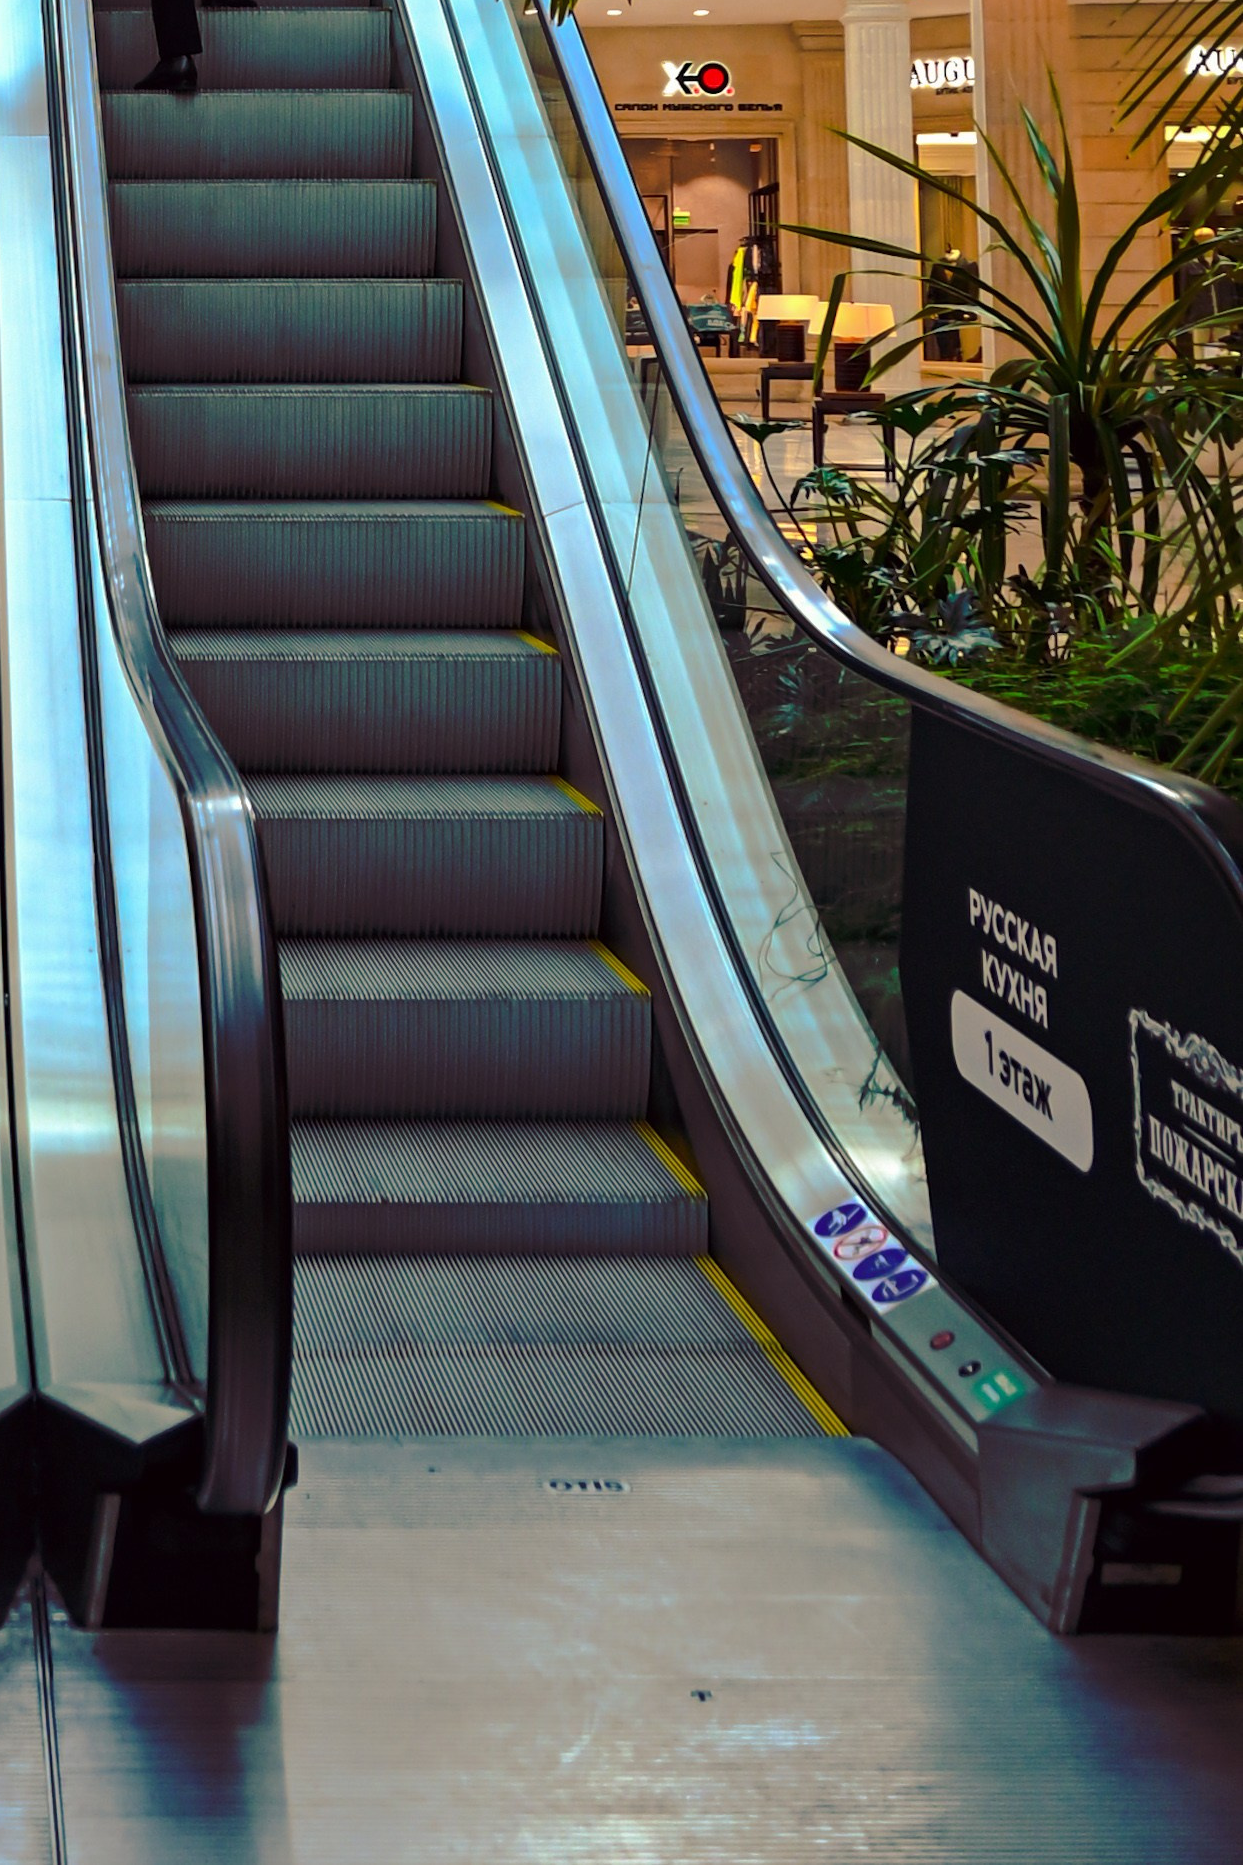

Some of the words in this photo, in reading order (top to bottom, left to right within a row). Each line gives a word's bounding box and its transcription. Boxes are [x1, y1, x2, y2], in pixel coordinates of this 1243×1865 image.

[969, 887, 1058, 979] РУССКАЯ
[982, 948, 1049, 1030] КУХНЯ
[984, 1030, 994, 1076] 1
[999, 1049, 1053, 1122] этаж
[1149, 1113, 1243, 1221] ПОЖАРСК
